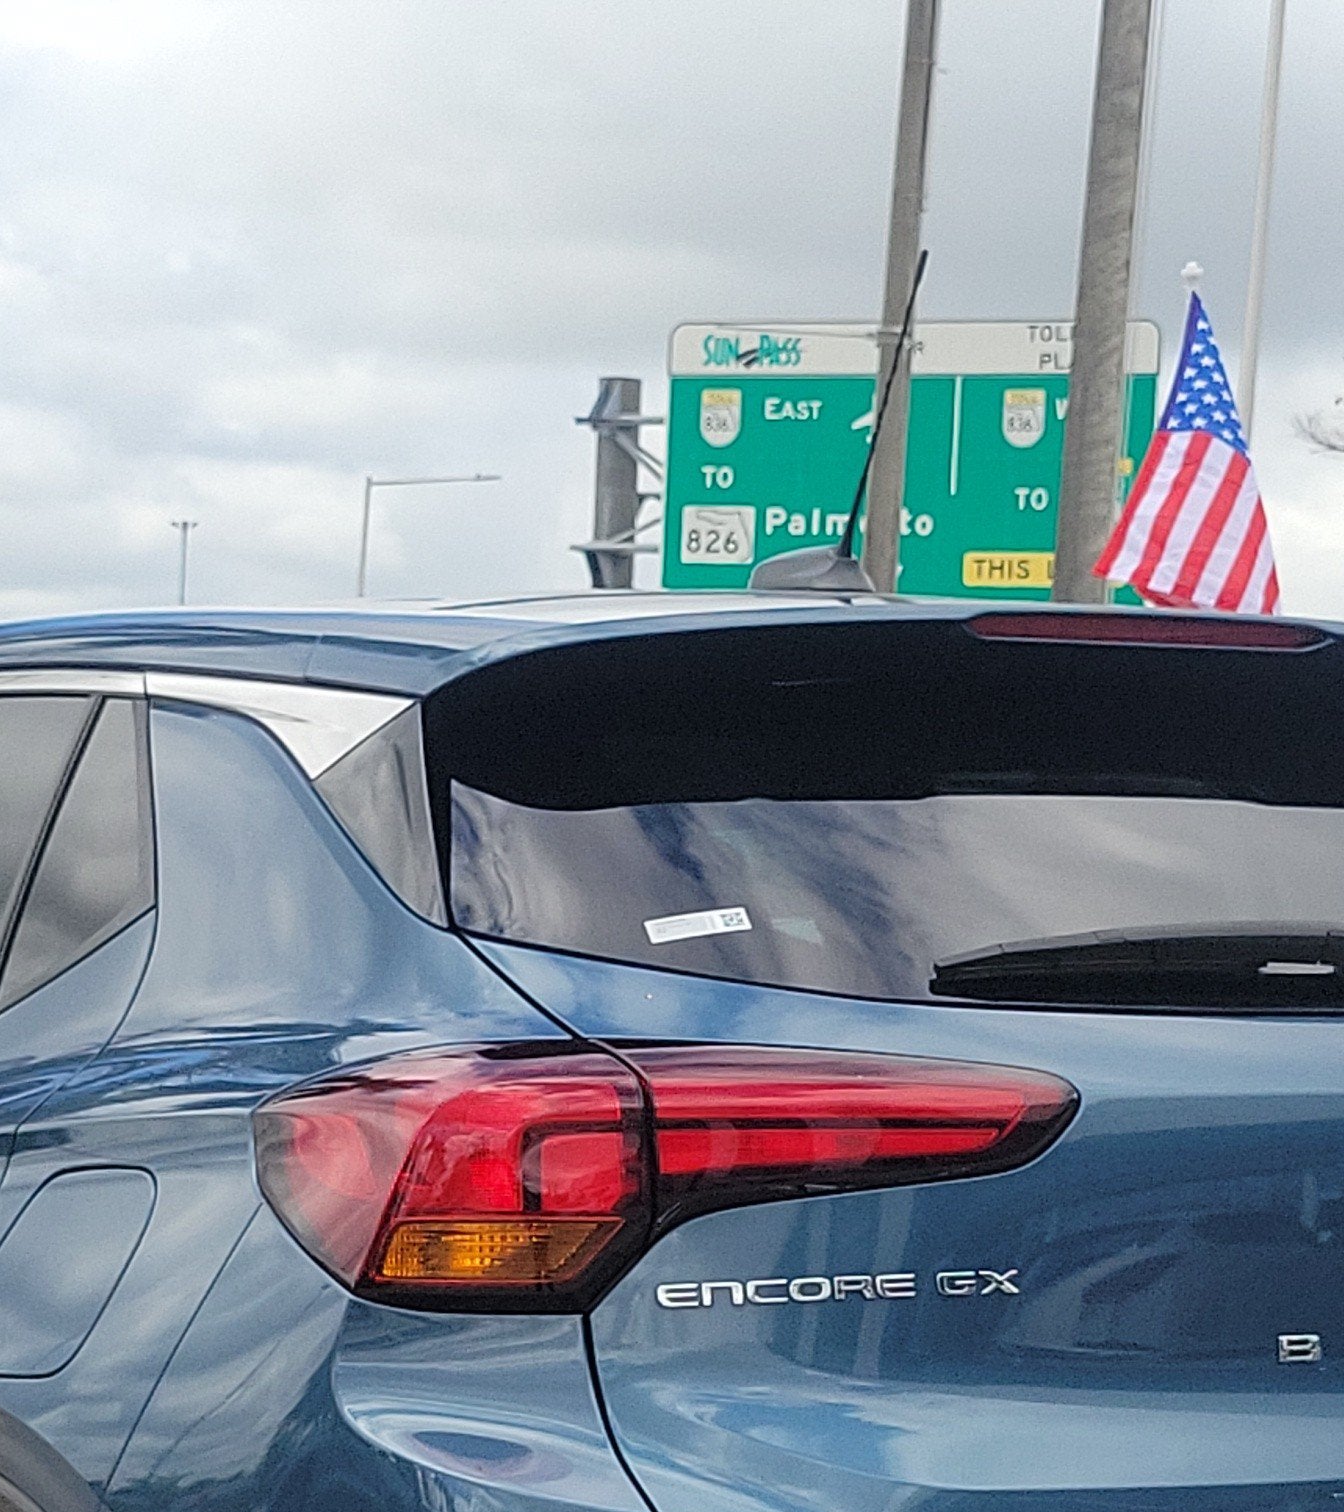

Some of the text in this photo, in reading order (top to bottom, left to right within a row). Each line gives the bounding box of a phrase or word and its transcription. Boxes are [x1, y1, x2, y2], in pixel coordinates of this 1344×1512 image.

[1027, 325, 1072, 343] TOL
[764, 397, 822, 420] EAST
[701, 465, 734, 489] TO
[1014, 487, 1049, 511] TO
[687, 529, 738, 553] 826
[973, 559, 1030, 579] THIS
[656, 1269, 1019, 1308] ENCORE GX
